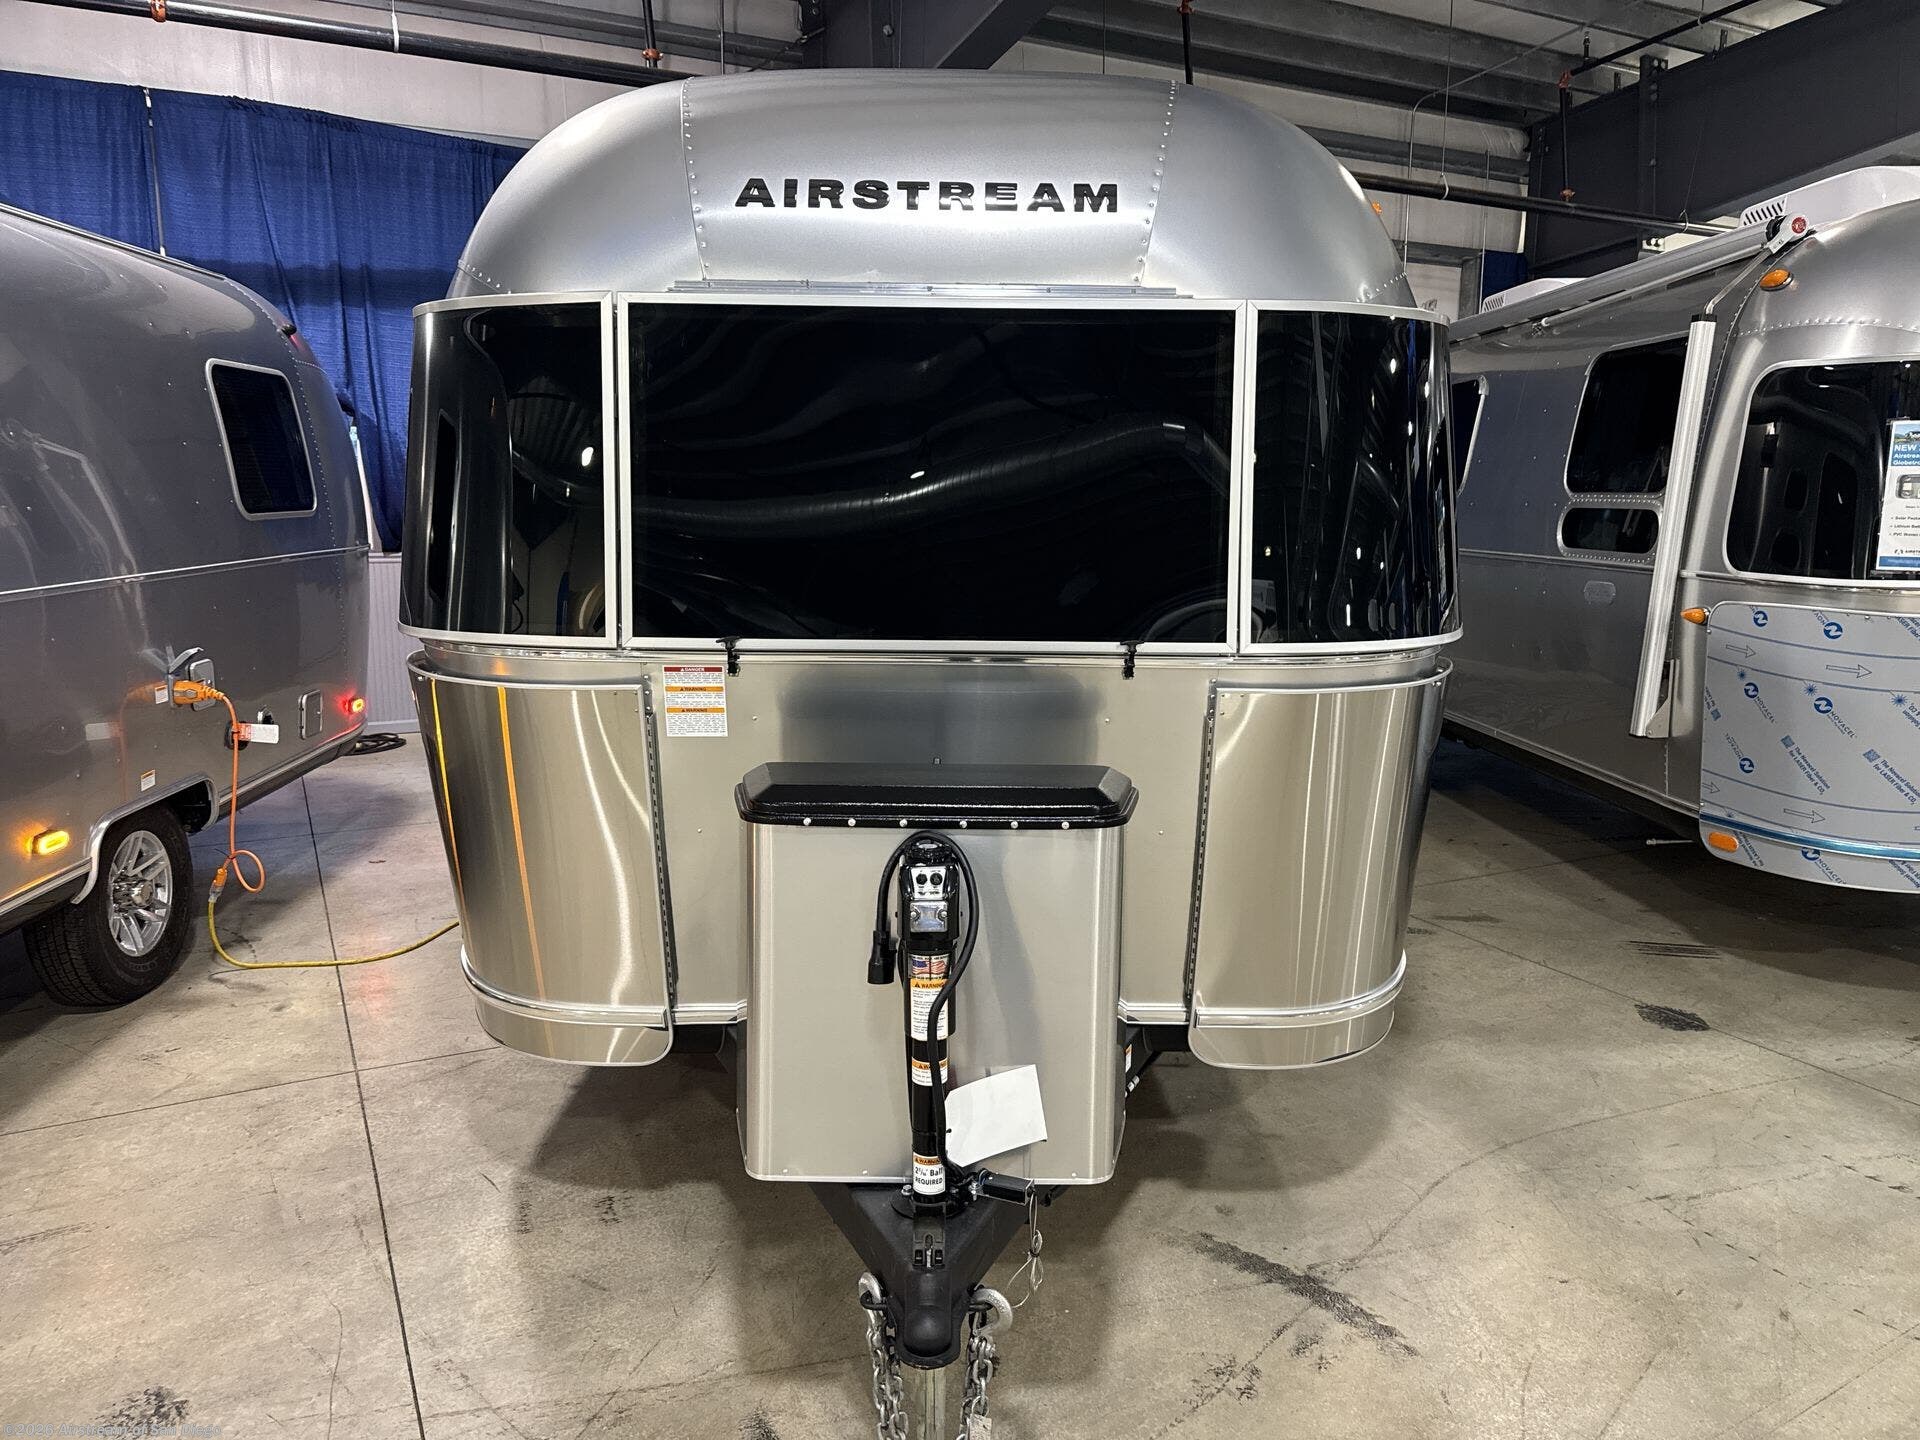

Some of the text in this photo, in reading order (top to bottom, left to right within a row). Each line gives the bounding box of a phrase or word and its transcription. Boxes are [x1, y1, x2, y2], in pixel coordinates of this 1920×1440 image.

[735, 178, 1117, 212] AIRSTREAM
[1829, 710, 1856, 739] NOVACEL
[1793, 756, 1807, 772] LASER
[1880, 759, 1891, 769] The
[1888, 766, 1907, 784] Novacel
[1873, 763, 1882, 772] for
[1879, 769, 1896, 785] LASER
[1893, 781, 1906, 794] Fiber
[1816, 858, 1843, 884] NOVACEL
[915, 1177, 943, 1185] REQUIRED
[930, 1167, 943, 1176] Ball
